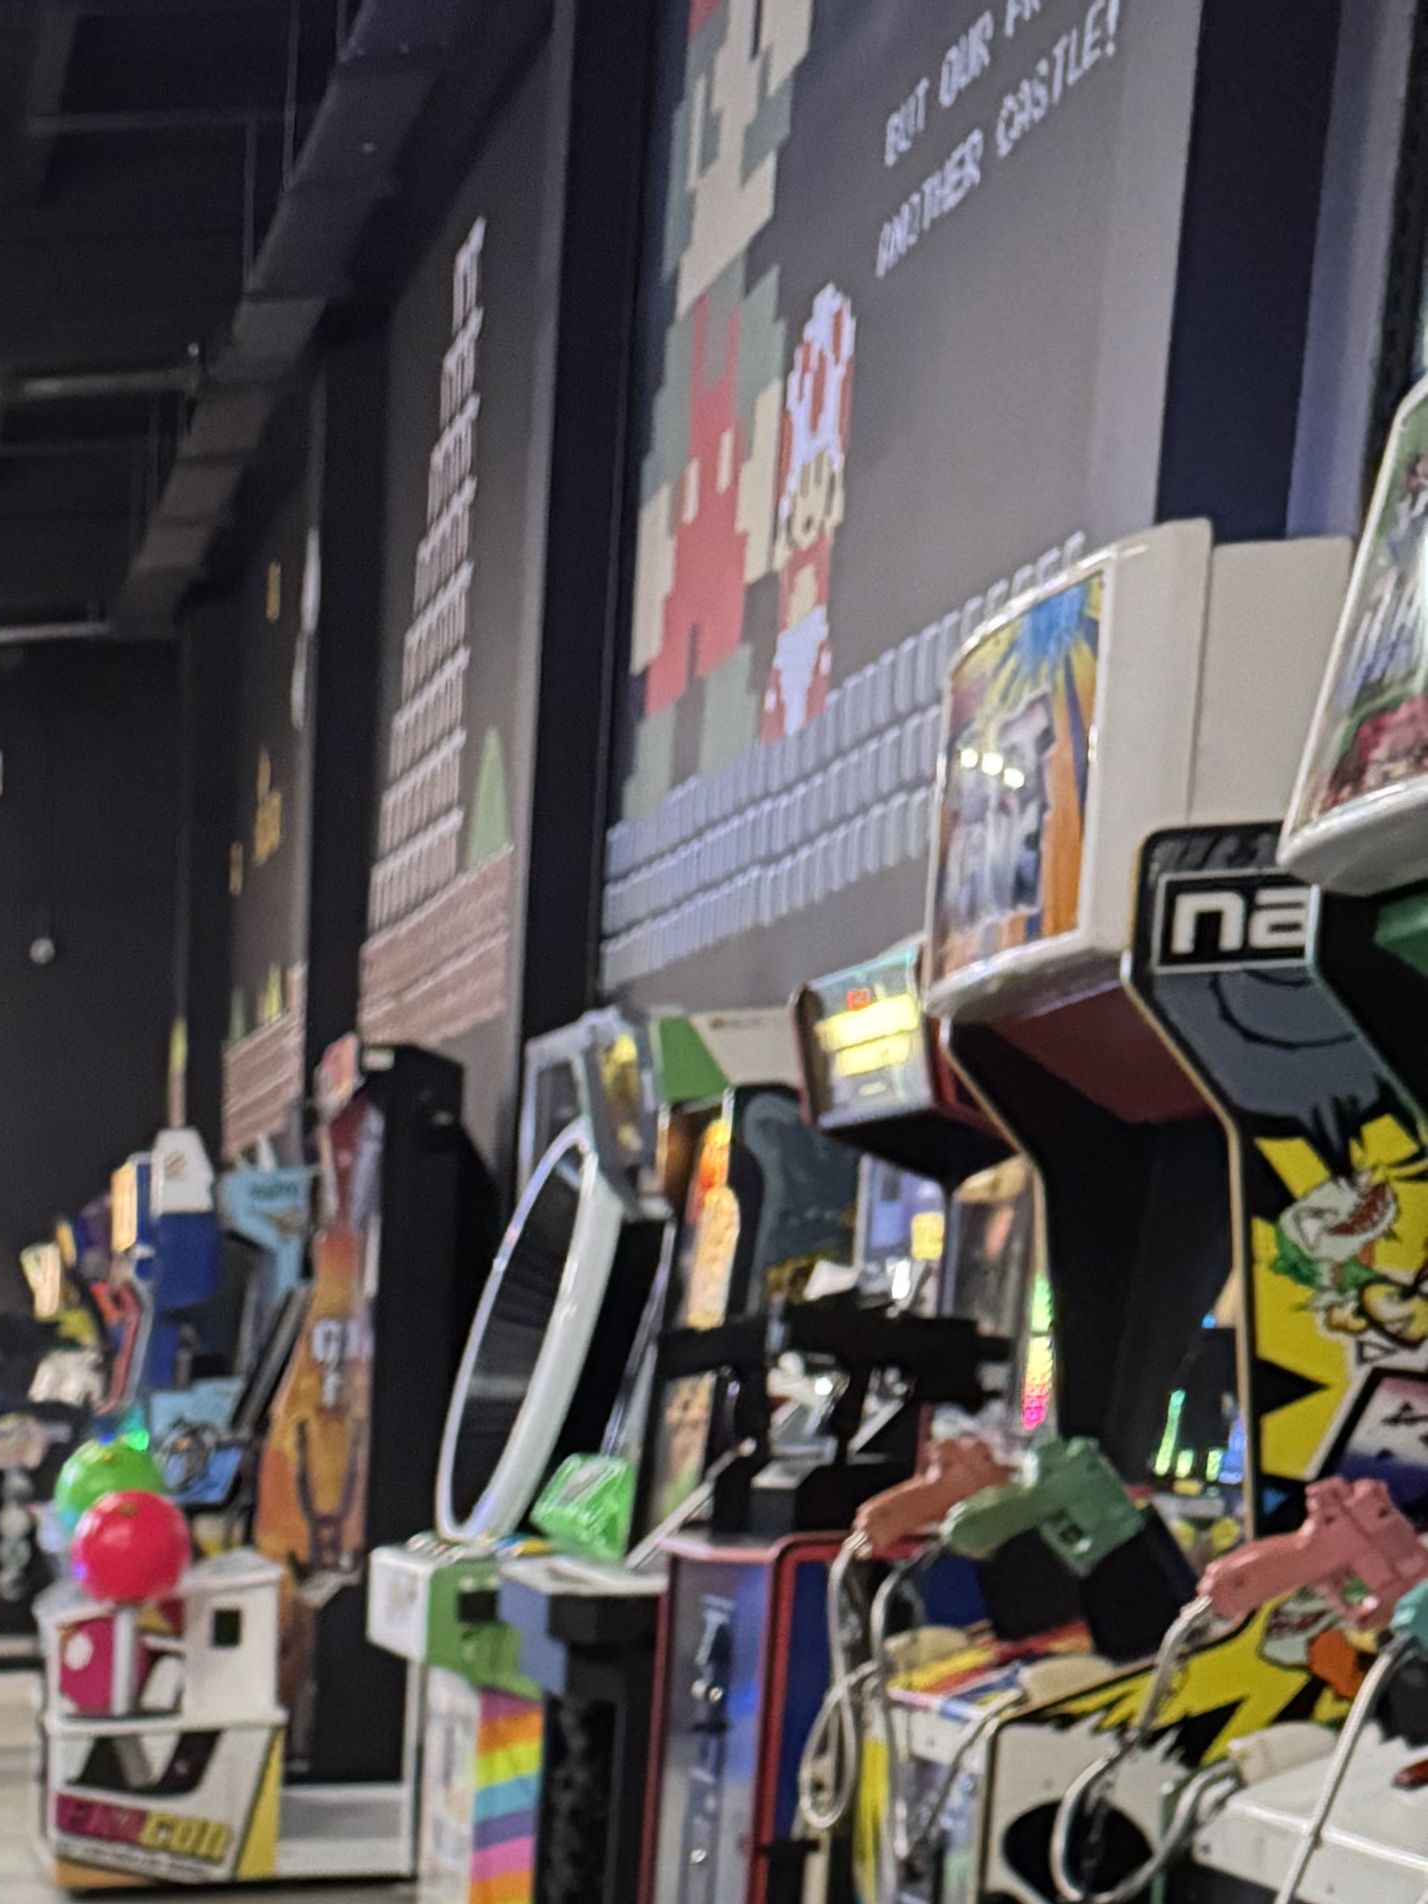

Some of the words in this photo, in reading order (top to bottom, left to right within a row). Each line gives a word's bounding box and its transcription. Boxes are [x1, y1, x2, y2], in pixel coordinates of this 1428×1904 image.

[885, 77, 929, 167] BUT
[939, 10, 994, 108] OUR
[875, 128, 984, 279] ANOTHER
